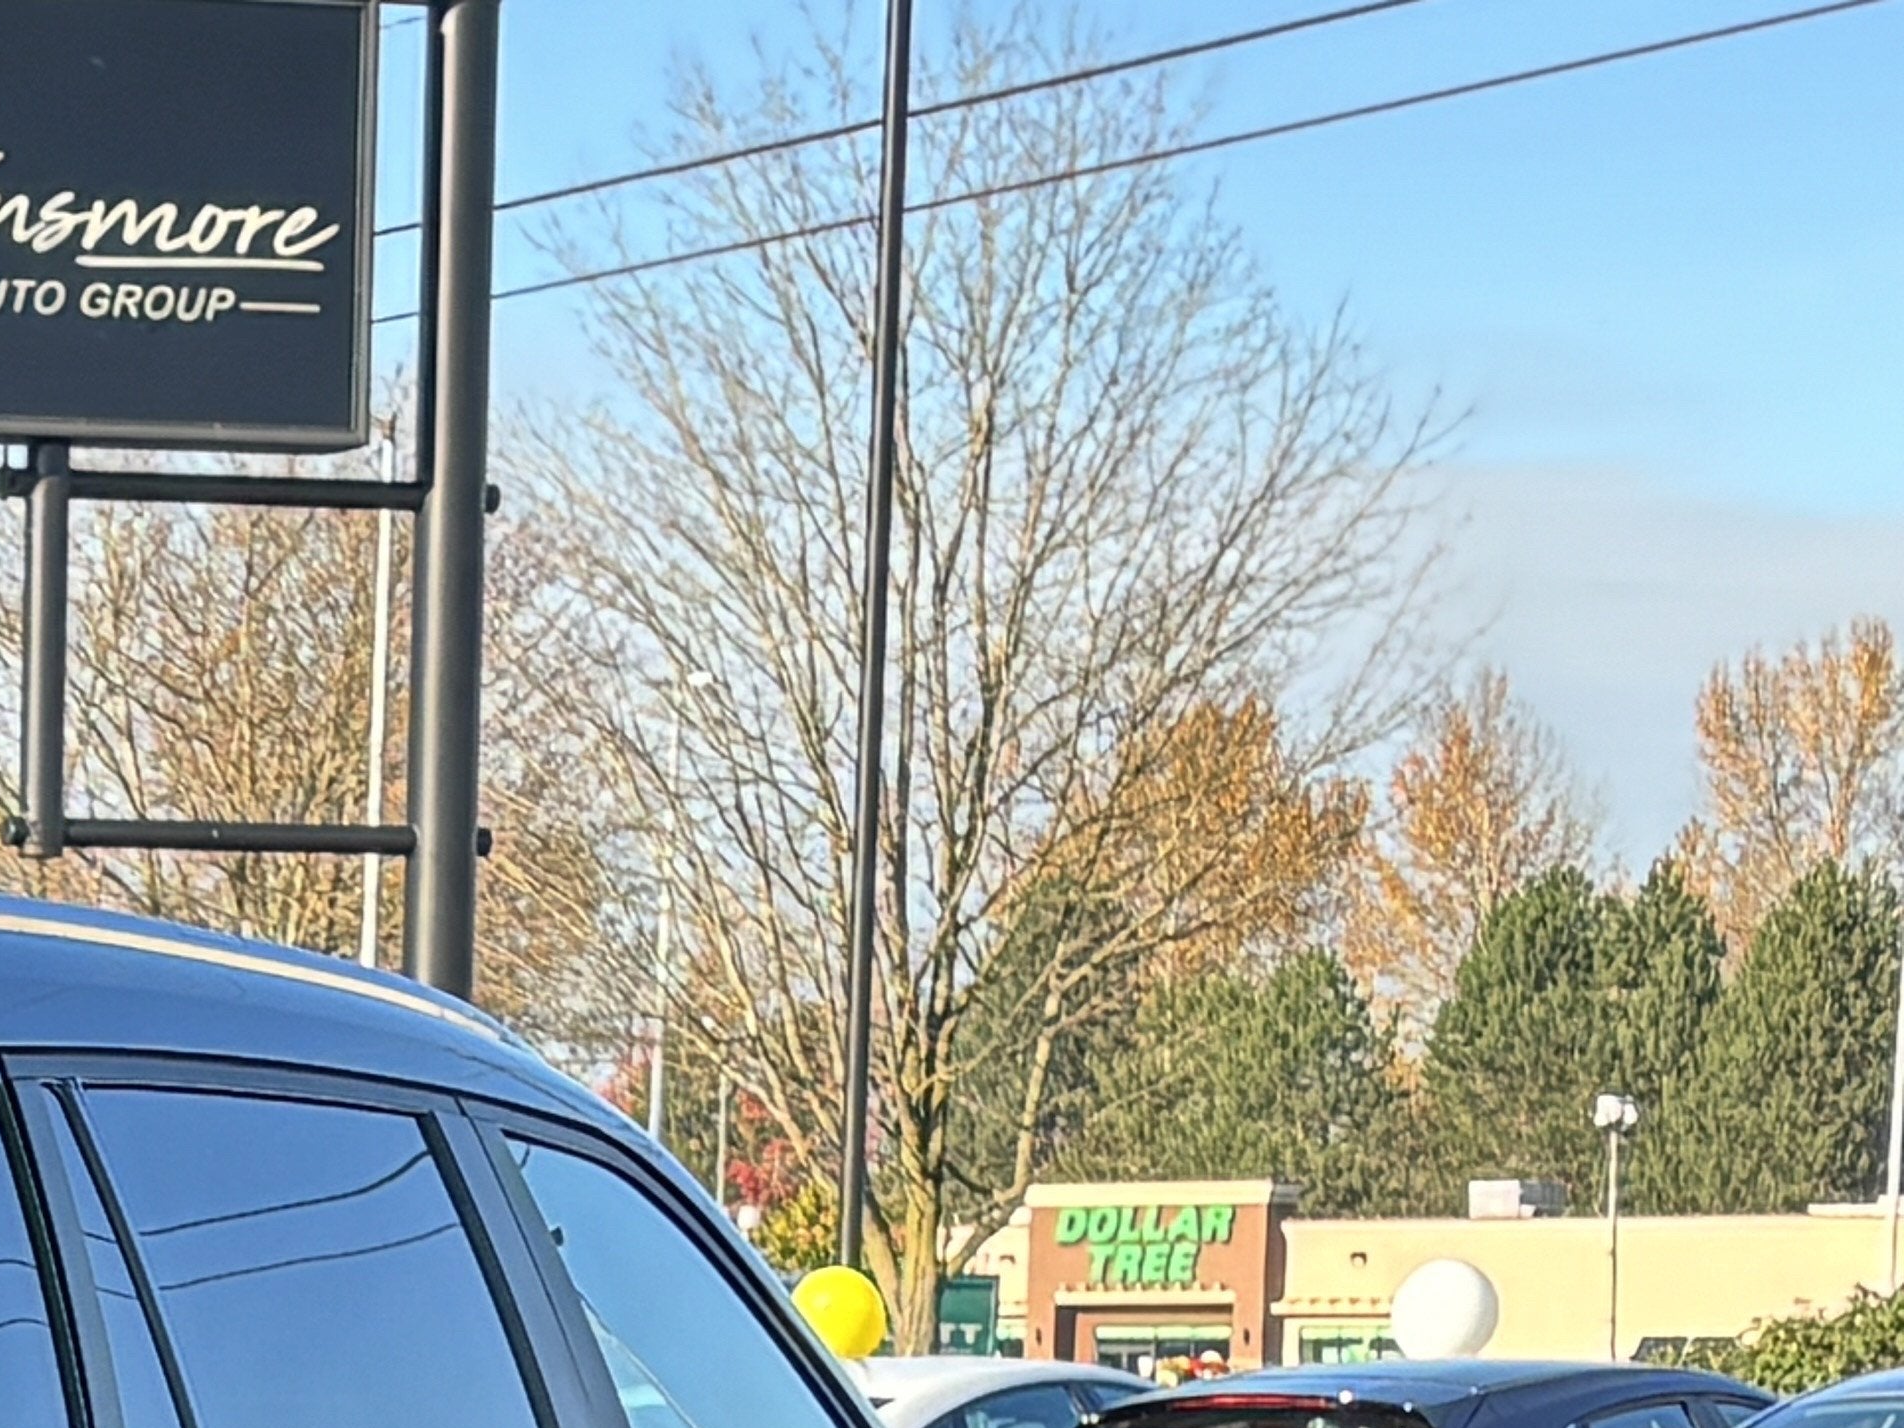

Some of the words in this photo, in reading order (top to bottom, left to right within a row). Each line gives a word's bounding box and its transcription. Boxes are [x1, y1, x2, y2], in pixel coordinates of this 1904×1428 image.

[79, 281, 236, 322] GROUP
[1056, 1205, 1235, 1245] DOLLAR
[1088, 1241, 1200, 1284] TREE
